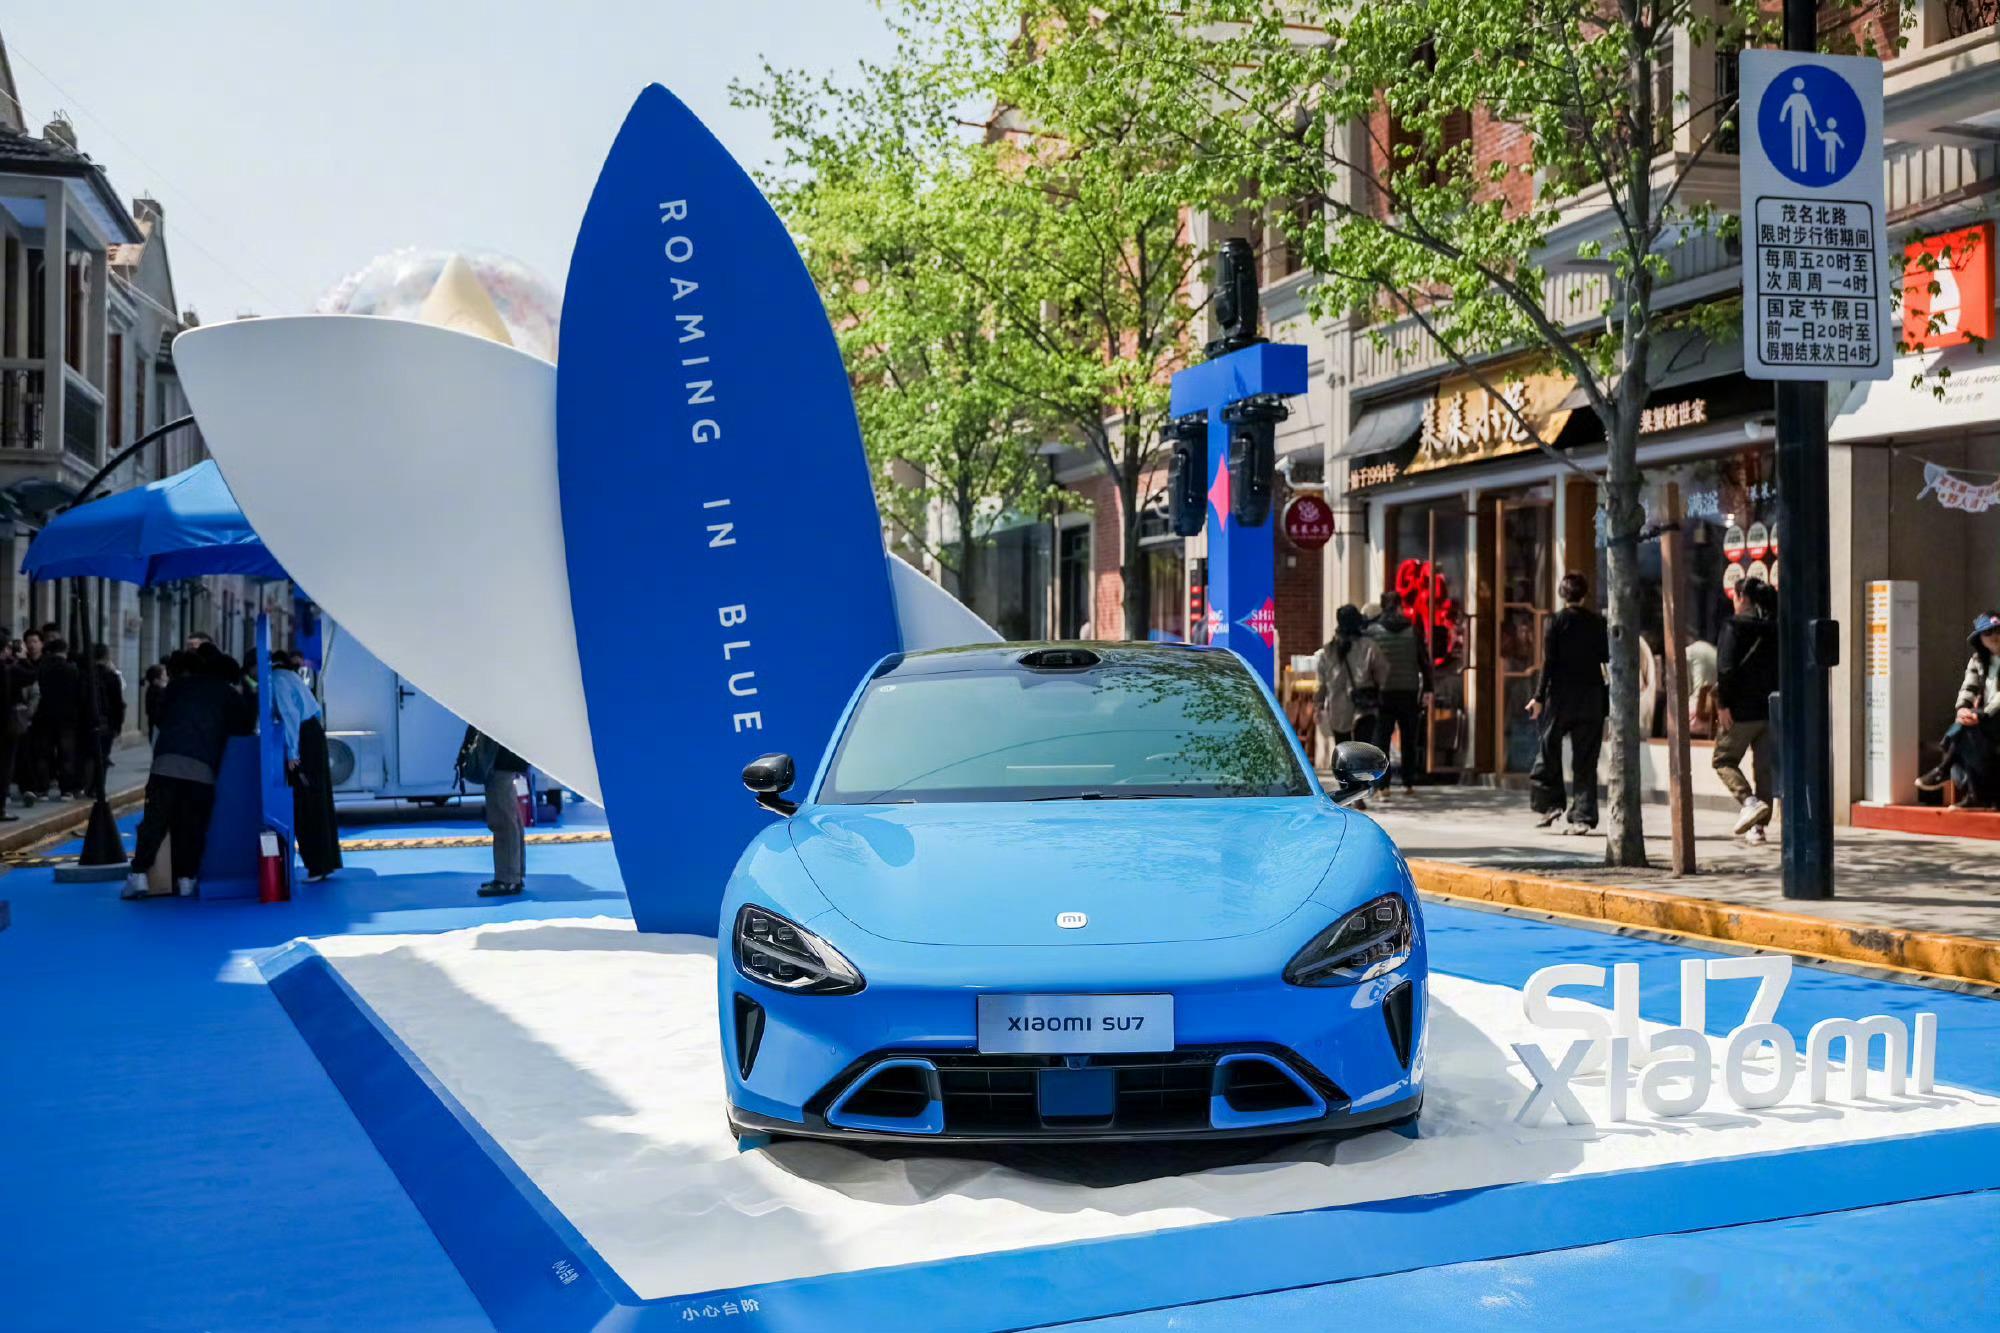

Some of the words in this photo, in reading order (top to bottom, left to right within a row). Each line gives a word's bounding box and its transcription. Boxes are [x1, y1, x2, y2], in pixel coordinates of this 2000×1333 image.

[1781, 204, 1848, 225] 茂名北路
[1761, 225, 1870, 248] 限时步行街期间
[1765, 249, 1869, 273] 每周五20时至
[1766, 272, 1869, 293] 次周周一4时
[1767, 298, 1870, 321] 国定节假日
[659, 199, 721, 444] ROAMING
[1766, 320, 1871, 342] 前一日20时至
[1766, 342, 1872, 363] 假期结束次日4时
[703, 498, 737, 548] IN
[718, 603, 763, 733] BLUE
[1102, 1016, 1145, 1031] SU7
[1523, 955, 1793, 1074] SU7
[682, 1298, 761, 1322] 小心台阶
